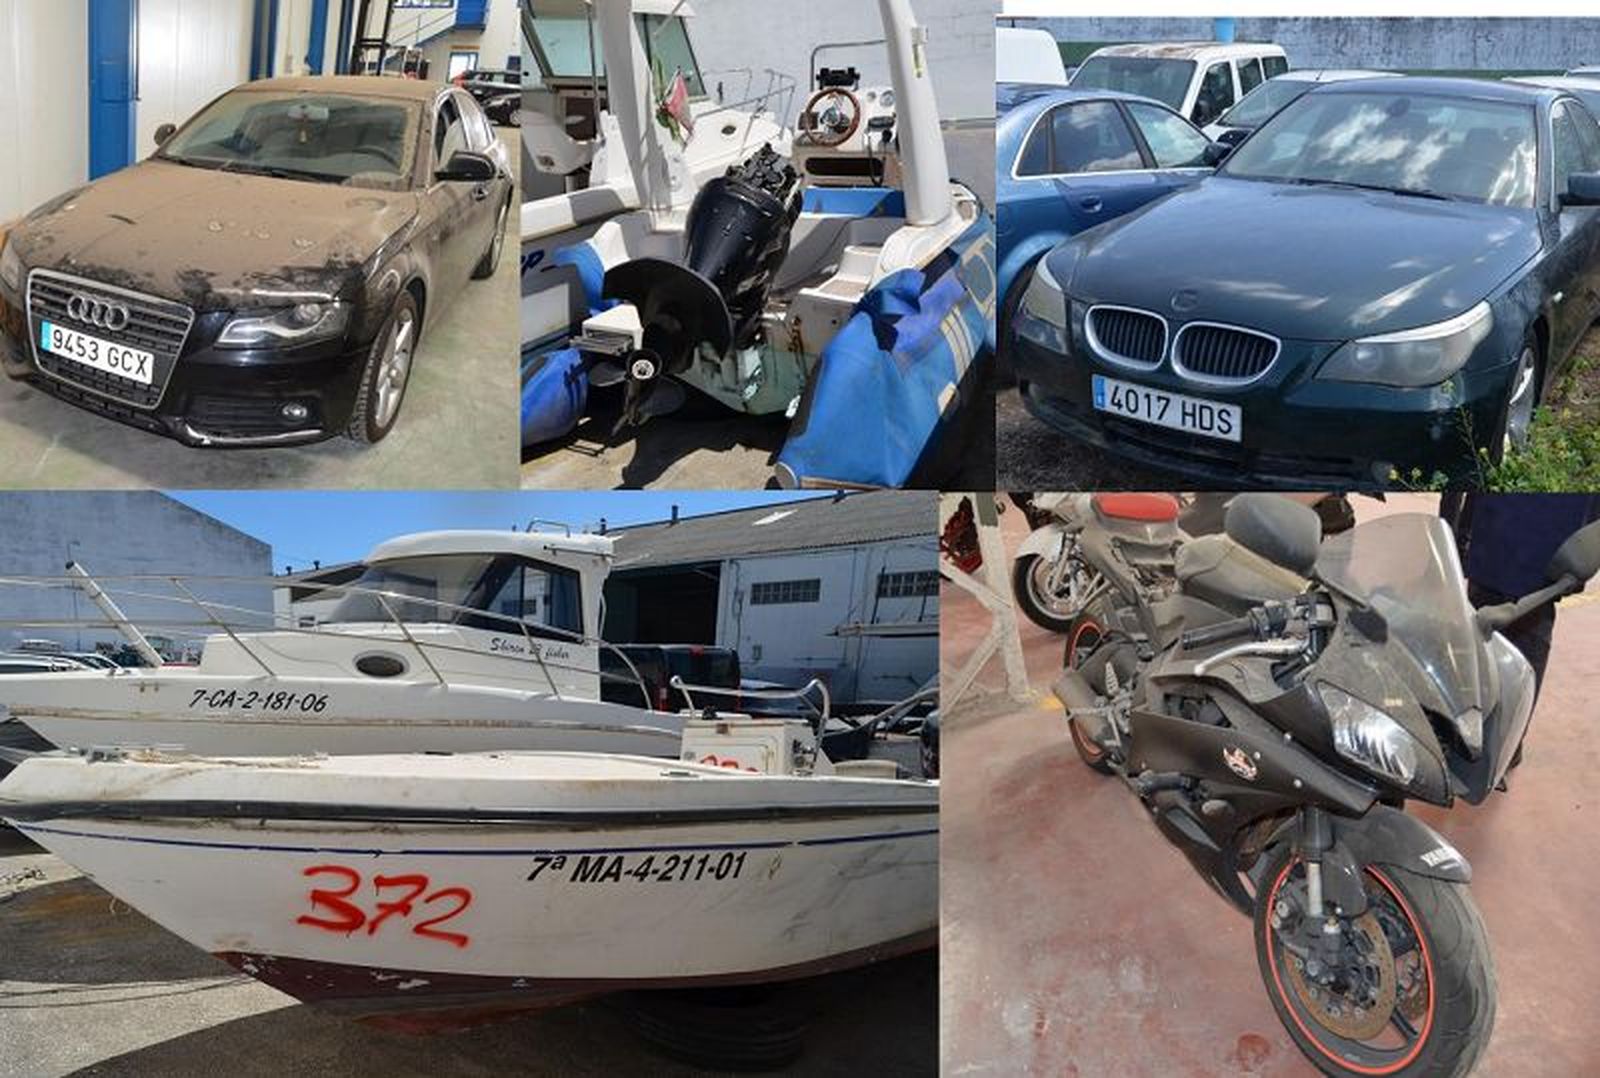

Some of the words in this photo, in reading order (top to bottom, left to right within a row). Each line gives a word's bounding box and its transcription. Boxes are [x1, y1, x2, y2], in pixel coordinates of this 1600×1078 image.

[53, 329, 99, 362] 9453
[106, 346, 148, 377] GCX
[1110, 385, 1171, 421] 4017
[1181, 399, 1233, 435] HDS
[189, 689, 329, 713] 7-CA-2-181-06
[569, 851, 748, 883] MA-4-211-01
[296, 865, 473, 948] 372
